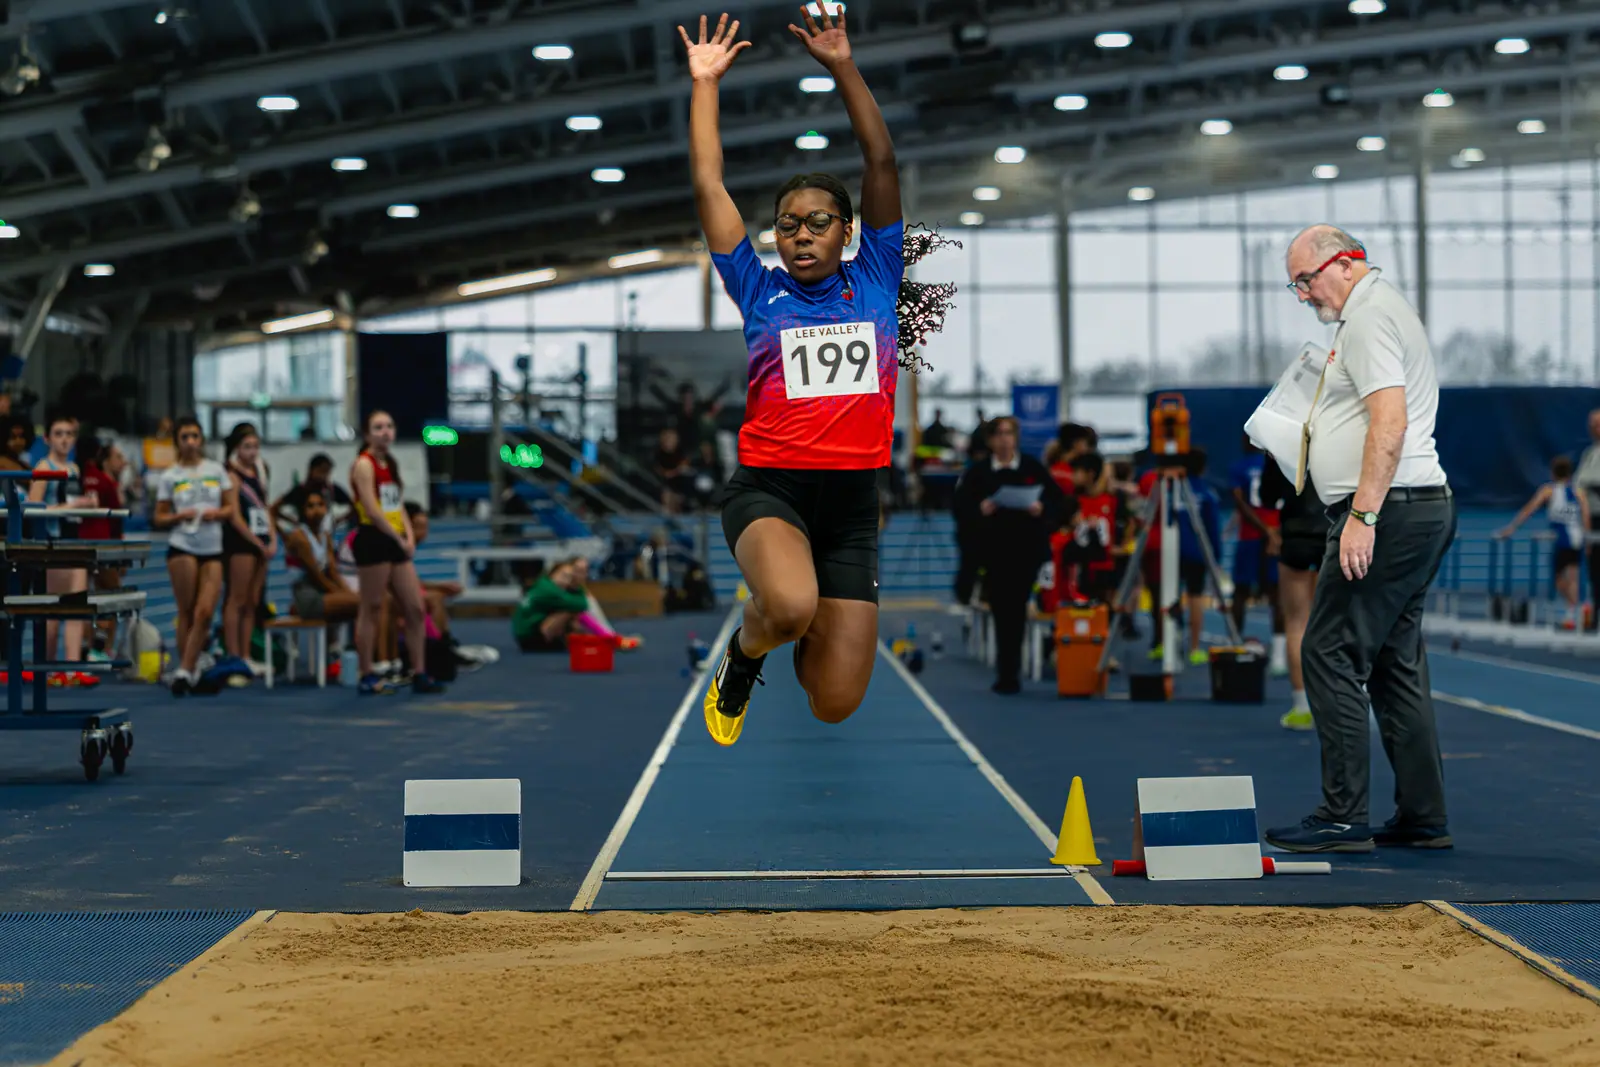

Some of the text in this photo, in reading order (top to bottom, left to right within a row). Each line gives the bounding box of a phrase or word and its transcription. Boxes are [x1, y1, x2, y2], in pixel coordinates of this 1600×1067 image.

[795, 324, 860, 339] LEE VALLEY
[791, 340, 871, 386] 199
